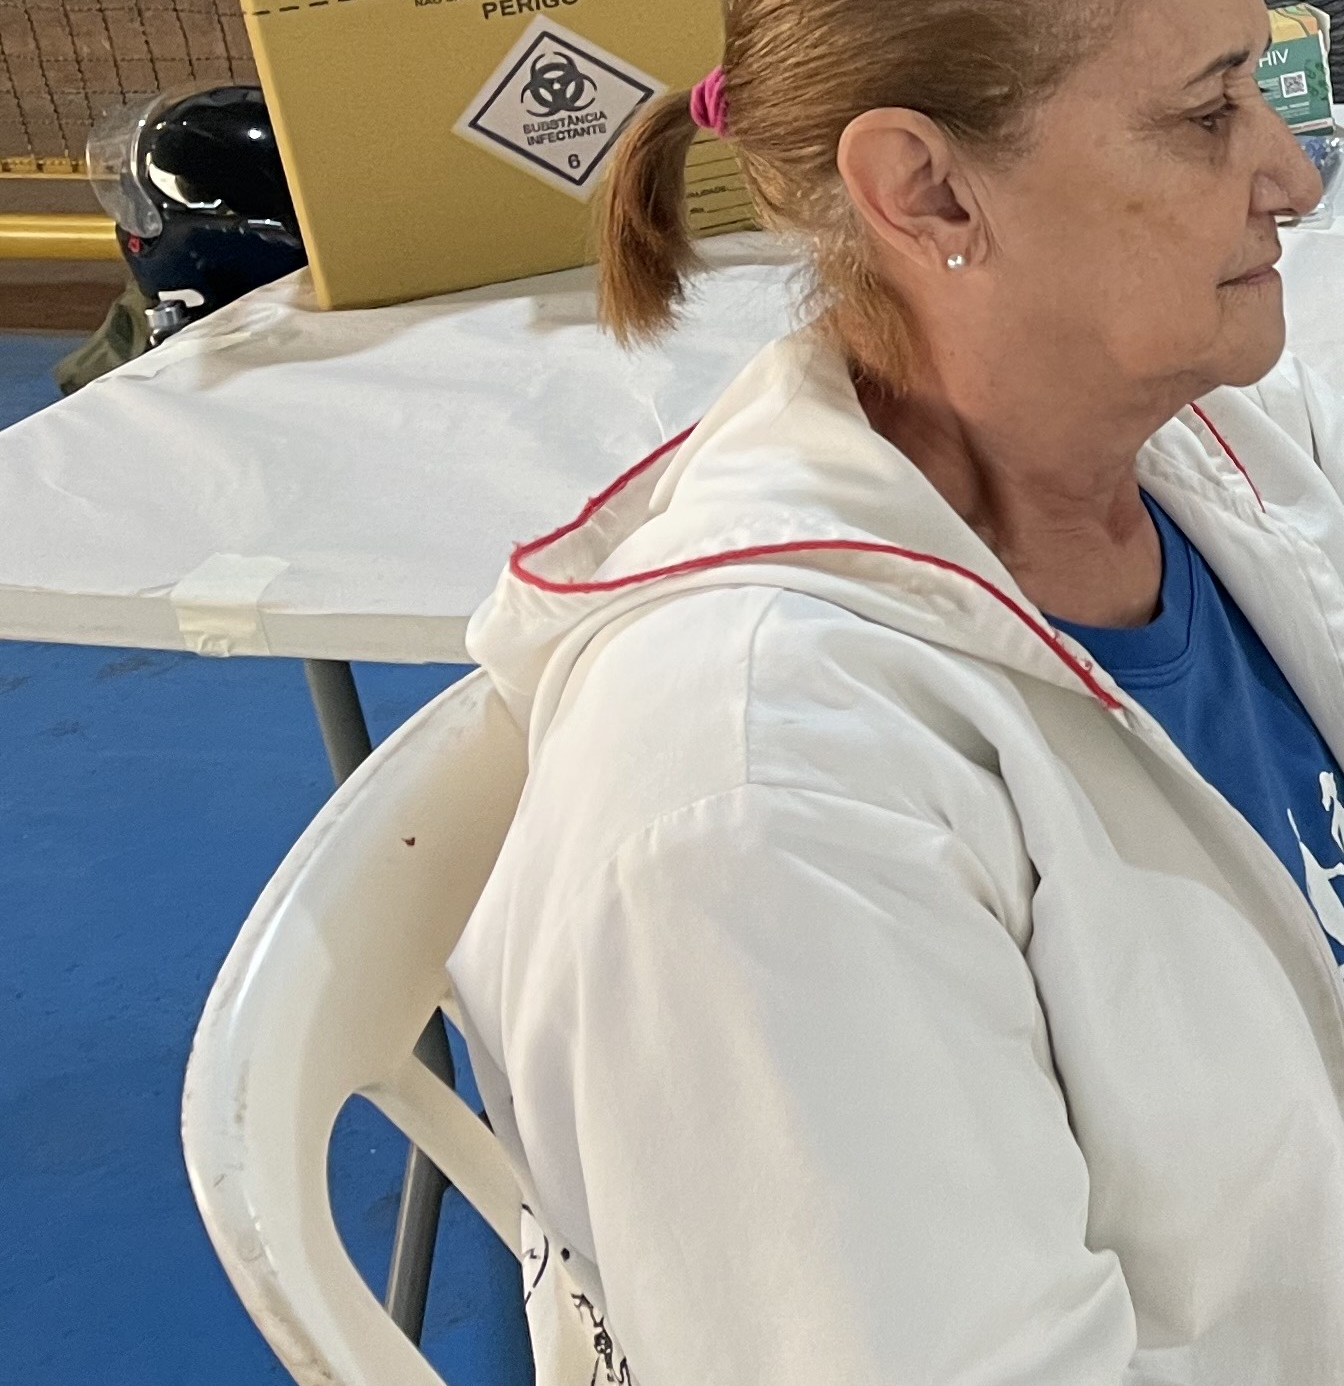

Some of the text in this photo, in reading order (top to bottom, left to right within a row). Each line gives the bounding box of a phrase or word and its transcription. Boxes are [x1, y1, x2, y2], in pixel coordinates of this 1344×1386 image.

[1259, 49, 1289, 68] HIV
[523, 111, 607, 134] SUBSTÂNCIA
[527, 122, 607, 146] INFECTANTE
[567, 154, 580, 169] 6
